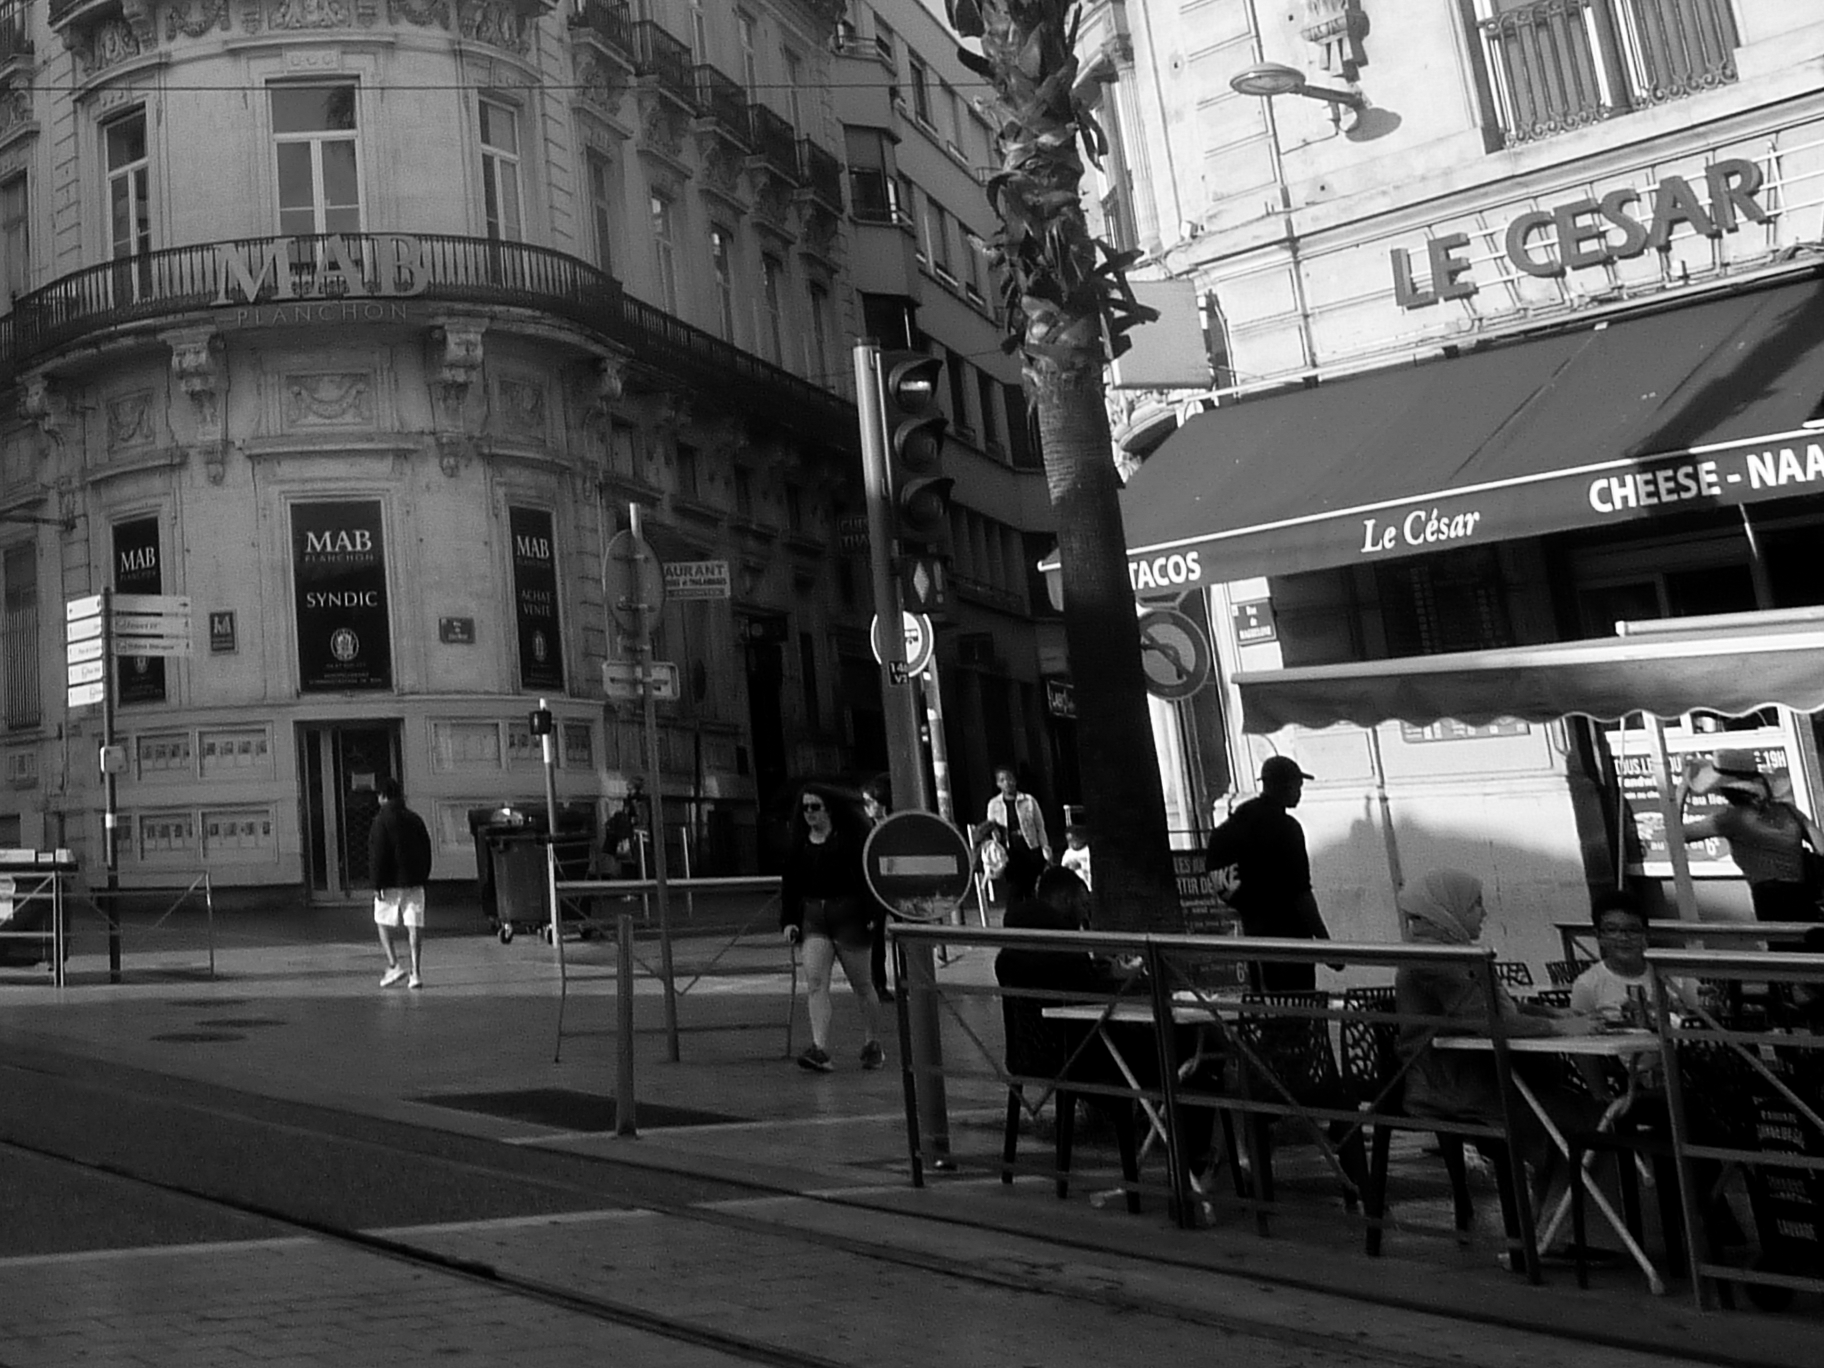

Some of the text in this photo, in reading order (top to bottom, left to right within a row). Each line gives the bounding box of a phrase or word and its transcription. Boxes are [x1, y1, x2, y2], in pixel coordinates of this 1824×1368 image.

[1388, 157, 1771, 312] LE CESAR
[210, 233, 431, 306] MAB
[237, 303, 408, 326] PLANCHON
[1588, 460, 1723, 514] CHEESE
[305, 529, 373, 553] MAB
[1360, 507, 1483, 554] Le César
[516, 535, 550, 559] MAB
[120, 546, 156, 573] MAB
[665, 564, 725, 578] AURANT
[1128, 550, 1202, 591] TACOS
[306, 590, 378, 609] SYNDIC
[521, 589, 551, 604] ACHAT
[522, 603, 551, 618] VENTE
[1762, 750, 1787, 769] 19H
